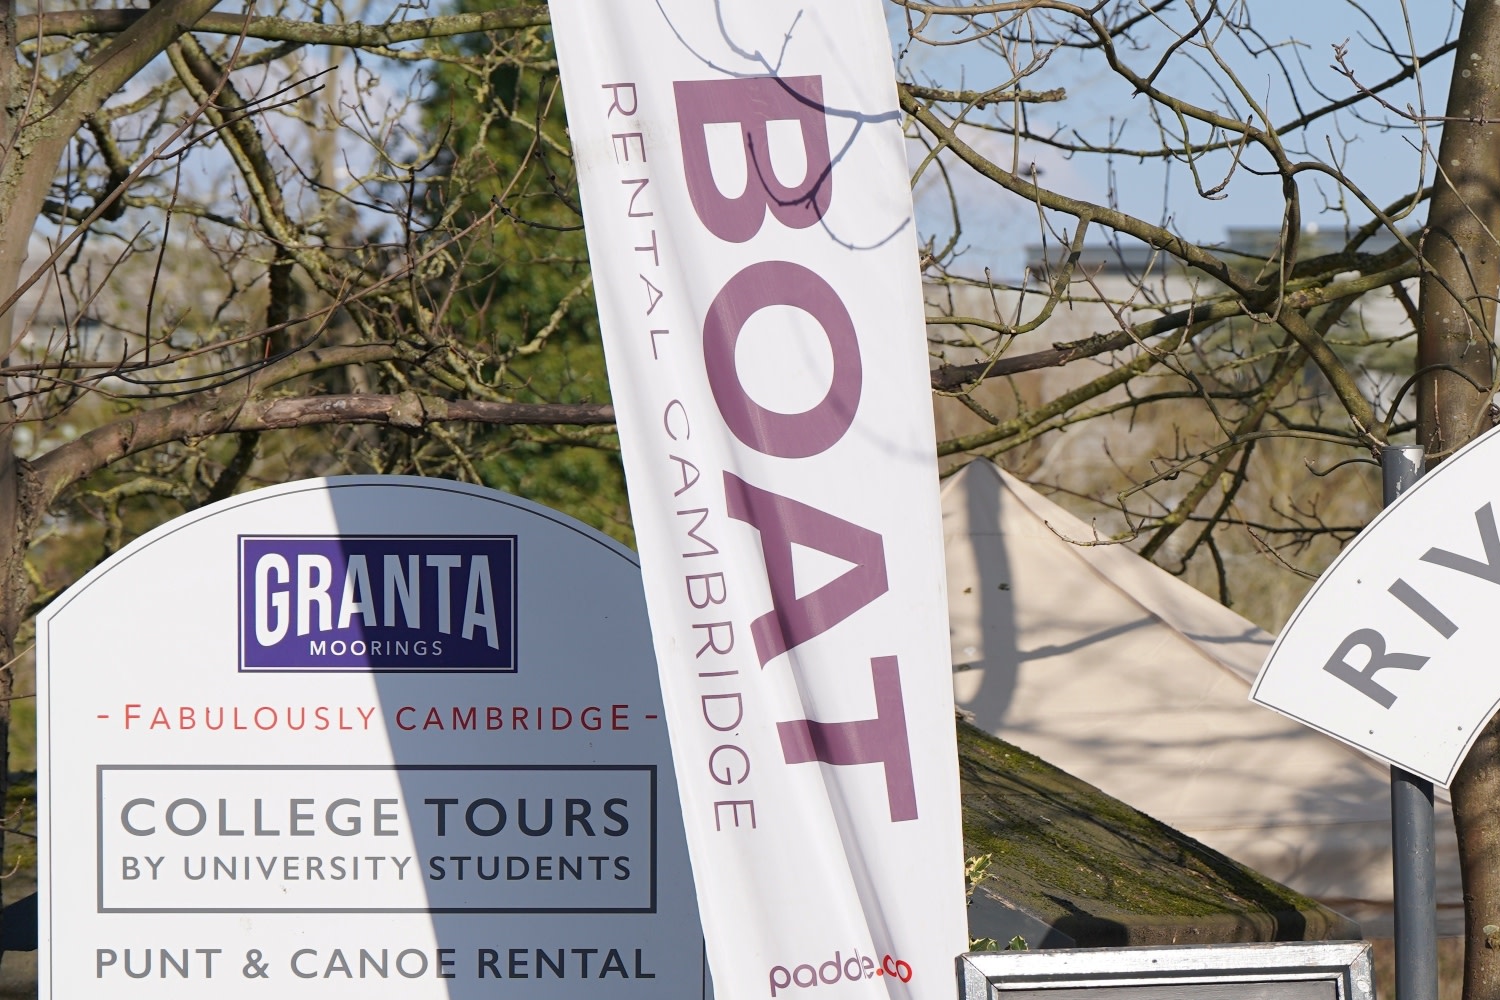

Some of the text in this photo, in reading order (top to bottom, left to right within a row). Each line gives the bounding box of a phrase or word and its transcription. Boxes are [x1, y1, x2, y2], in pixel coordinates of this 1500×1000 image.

[601, 83, 757, 833] RENTAL CAMBRIDGE
[673, 75, 918, 822] BOAT
[255, 553, 500, 650] GRANTA
[309, 640, 443, 656] MOORINGS
[124, 703, 631, 731] FABULOUSLY CAMBRIDGE
[120, 797, 630, 838] COLLEGE TOURS
[121, 856, 631, 881] BY UNIVERSITY STUDENTS
[96, 947, 657, 980] PUNT & CANOE RENTAL
